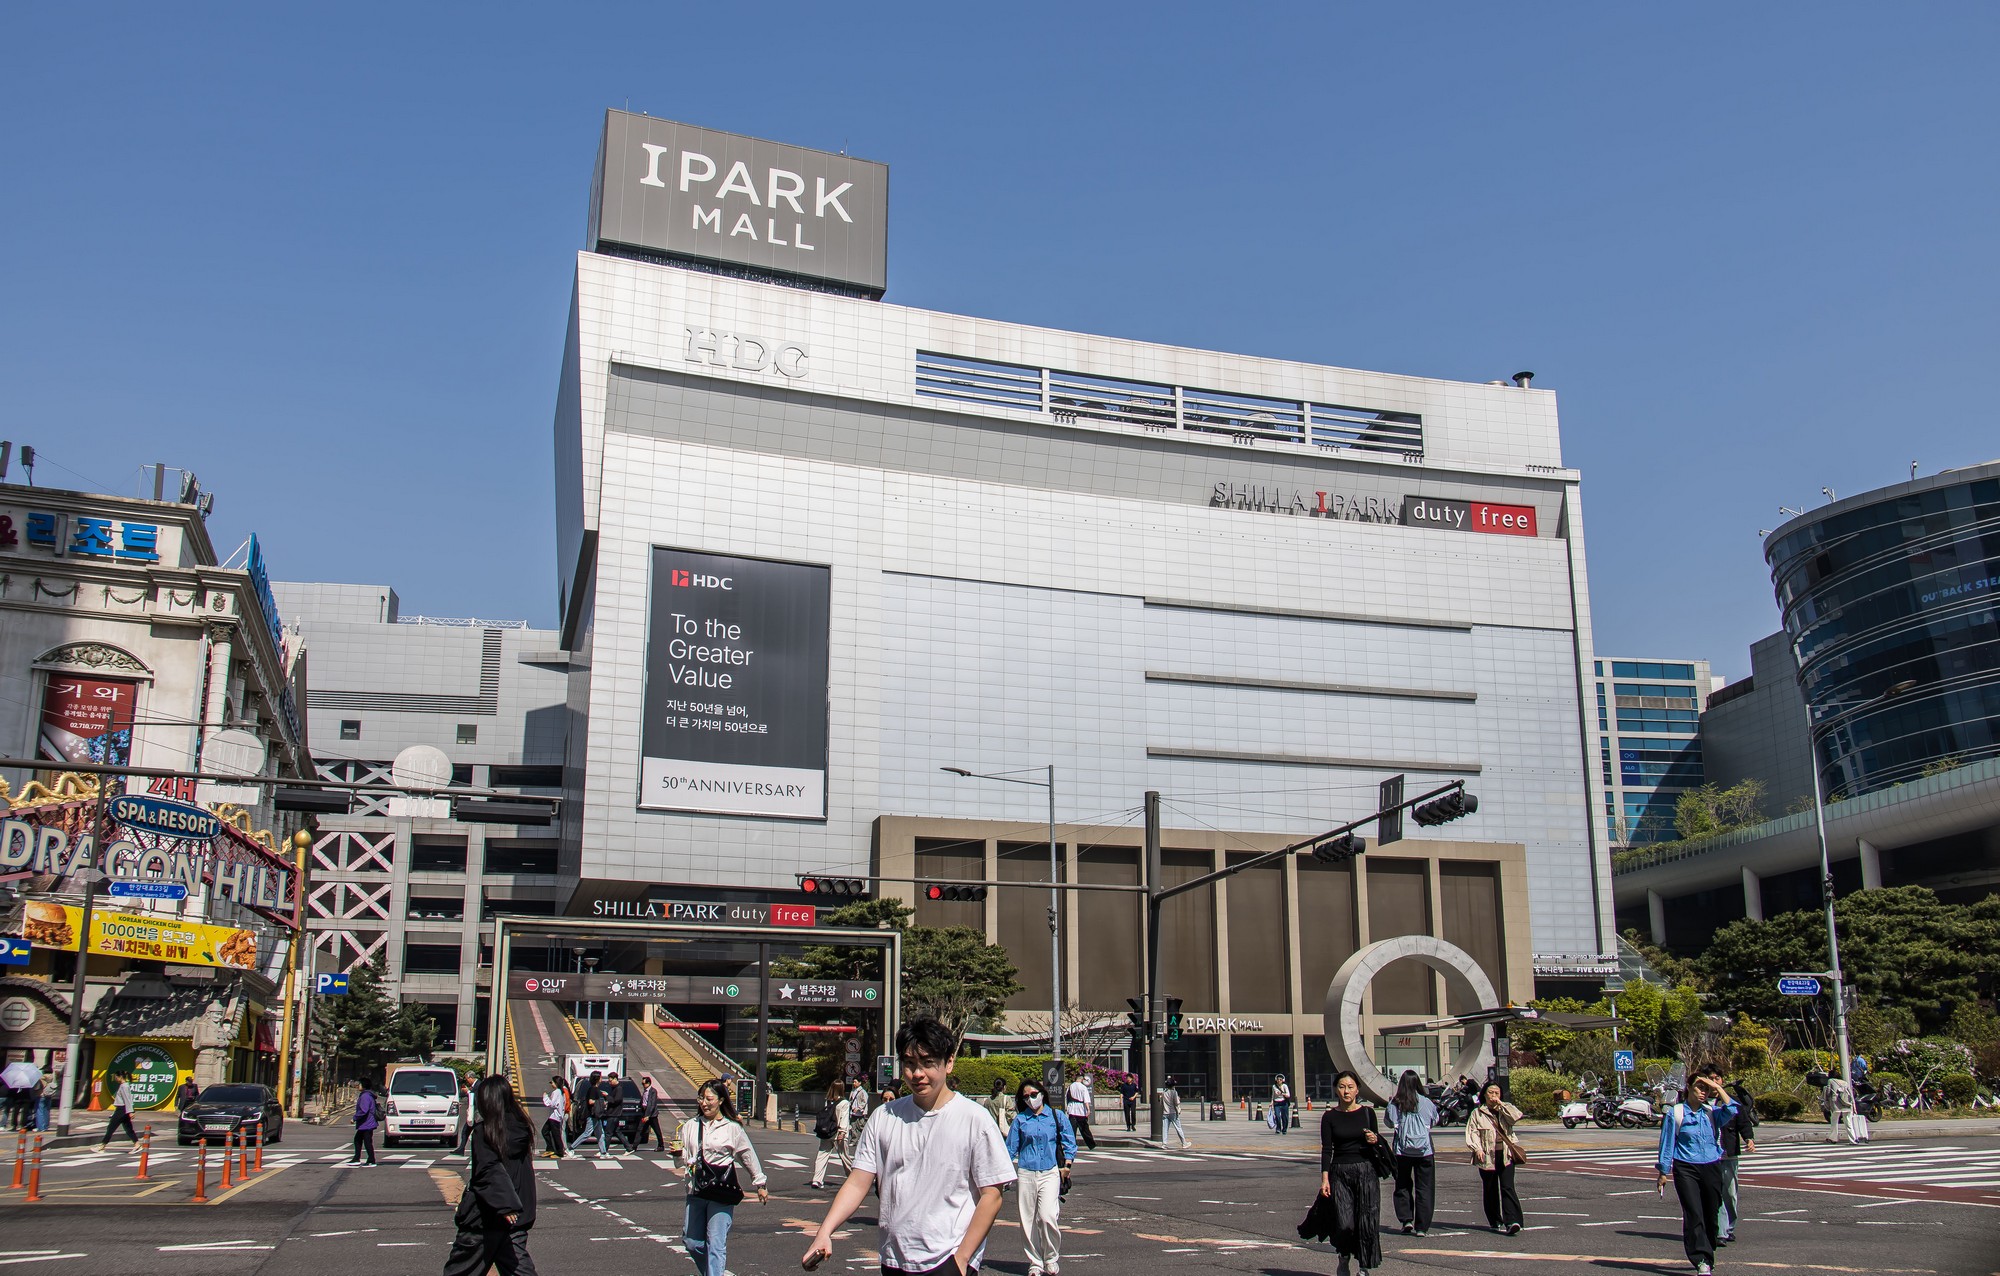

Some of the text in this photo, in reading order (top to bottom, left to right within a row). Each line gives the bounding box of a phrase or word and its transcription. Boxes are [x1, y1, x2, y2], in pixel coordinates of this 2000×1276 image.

[640, 143, 853, 223] IPARK
[692, 204, 815, 251] MALL
[685, 324, 809, 378] HDC
[1212, 481, 1529, 528] SHILLA IPARK duty free
[0, 512, 160, 561] & 리조트
[693, 574, 733, 591] HDC
[671, 613, 741, 640] To the
[669, 639, 754, 666] Greater
[668, 663, 733, 689] Value
[57, 684, 125, 701] 기와
[667, 699, 749, 718] 지난 50년을 넘어,
[666, 716, 768, 734] 더 큰 가치의 50년으로
[148, 776, 195, 802] 24H
[661, 776, 806, 798] 50th ANNIVERSARY
[117, 800, 217, 835] SPA & RESORT
[0, 818, 295, 911] DRAGON HILL
[593, 900, 809, 923] SHILLA IPARK duty free
[102, 922, 196, 945] 1000번을 연구한
[143, 920, 166, 928] CHICKEN
[101, 938, 188, 959] 수제치킨 & 버거
[317, 974, 332, 992] P
[541, 978, 567, 988] OUT
[627, 980, 667, 991] 해주차장
[712, 986, 724, 995] IN
[799, 984, 836, 996] 별주차장
[852, 989, 862, 998] IN
[1188, 1017, 1264, 1030] IPARK MALL
[1398, 1038, 1411, 1046] H&M
[114, 1046, 174, 1068] KOREAN CHICKEN CLUB
[147, 1084, 154, 1092] &
[149, 1074, 174, 1082] 연구한
[132, 1094, 158, 1102] 킨버거
